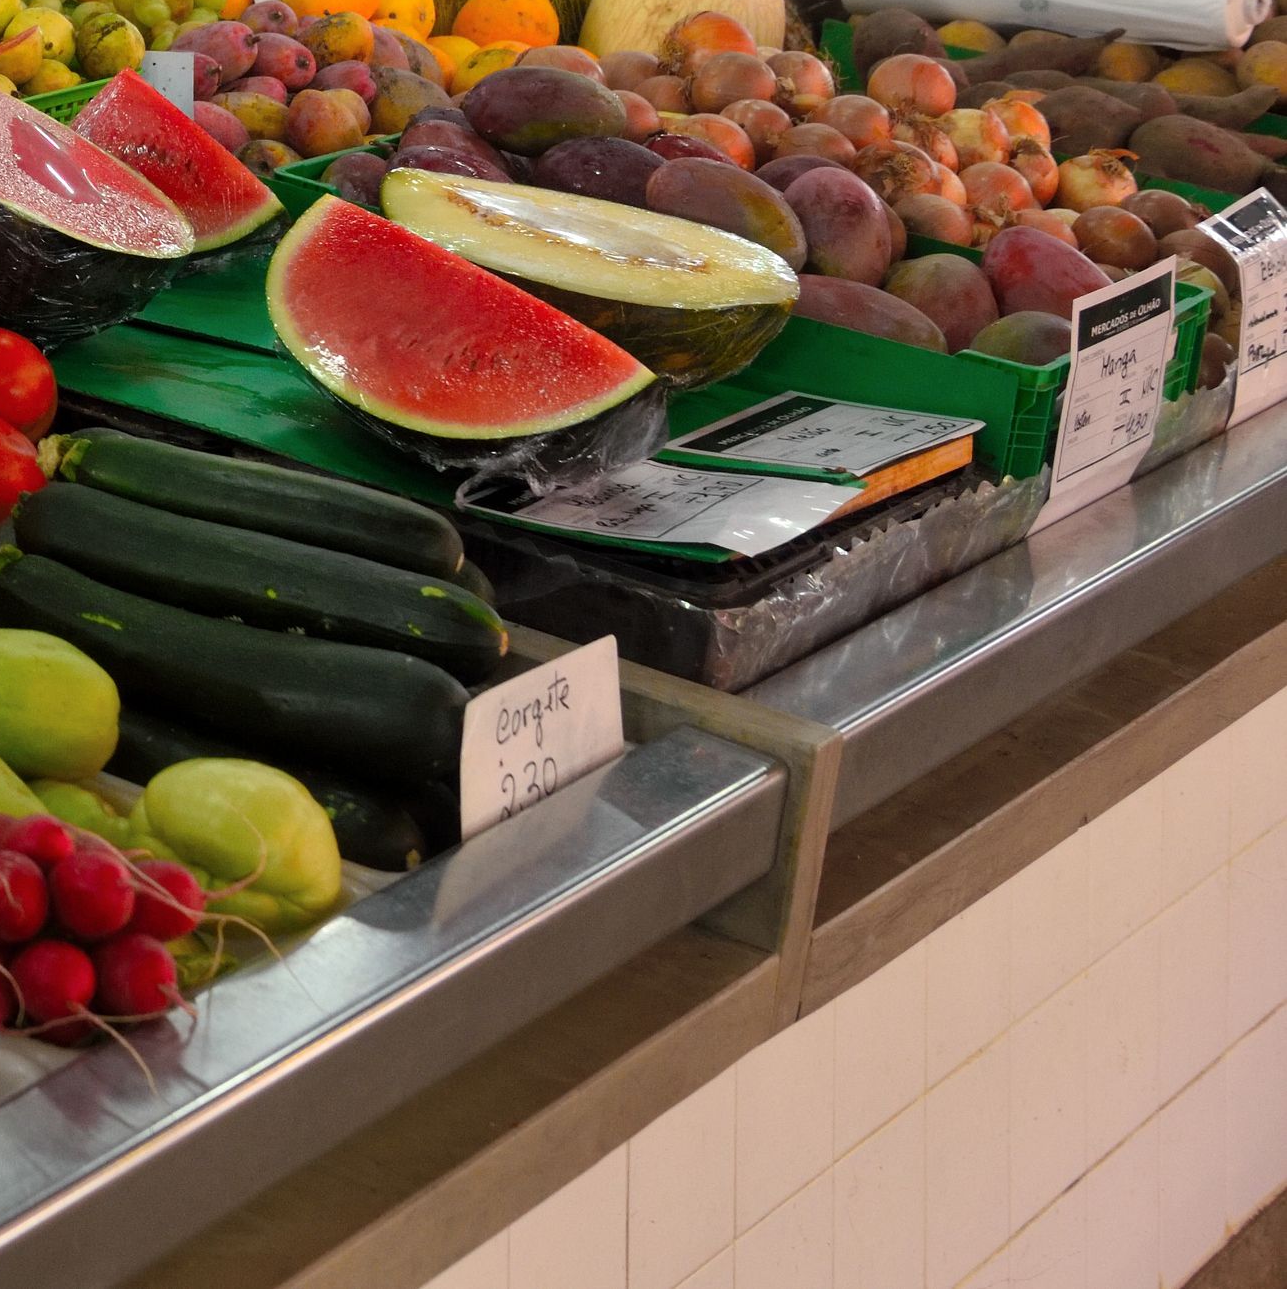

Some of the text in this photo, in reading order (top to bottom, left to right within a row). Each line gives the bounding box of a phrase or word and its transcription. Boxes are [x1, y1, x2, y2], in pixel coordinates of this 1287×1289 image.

[1090, 297, 1162, 338] MERCADOS DE OLHÃO
